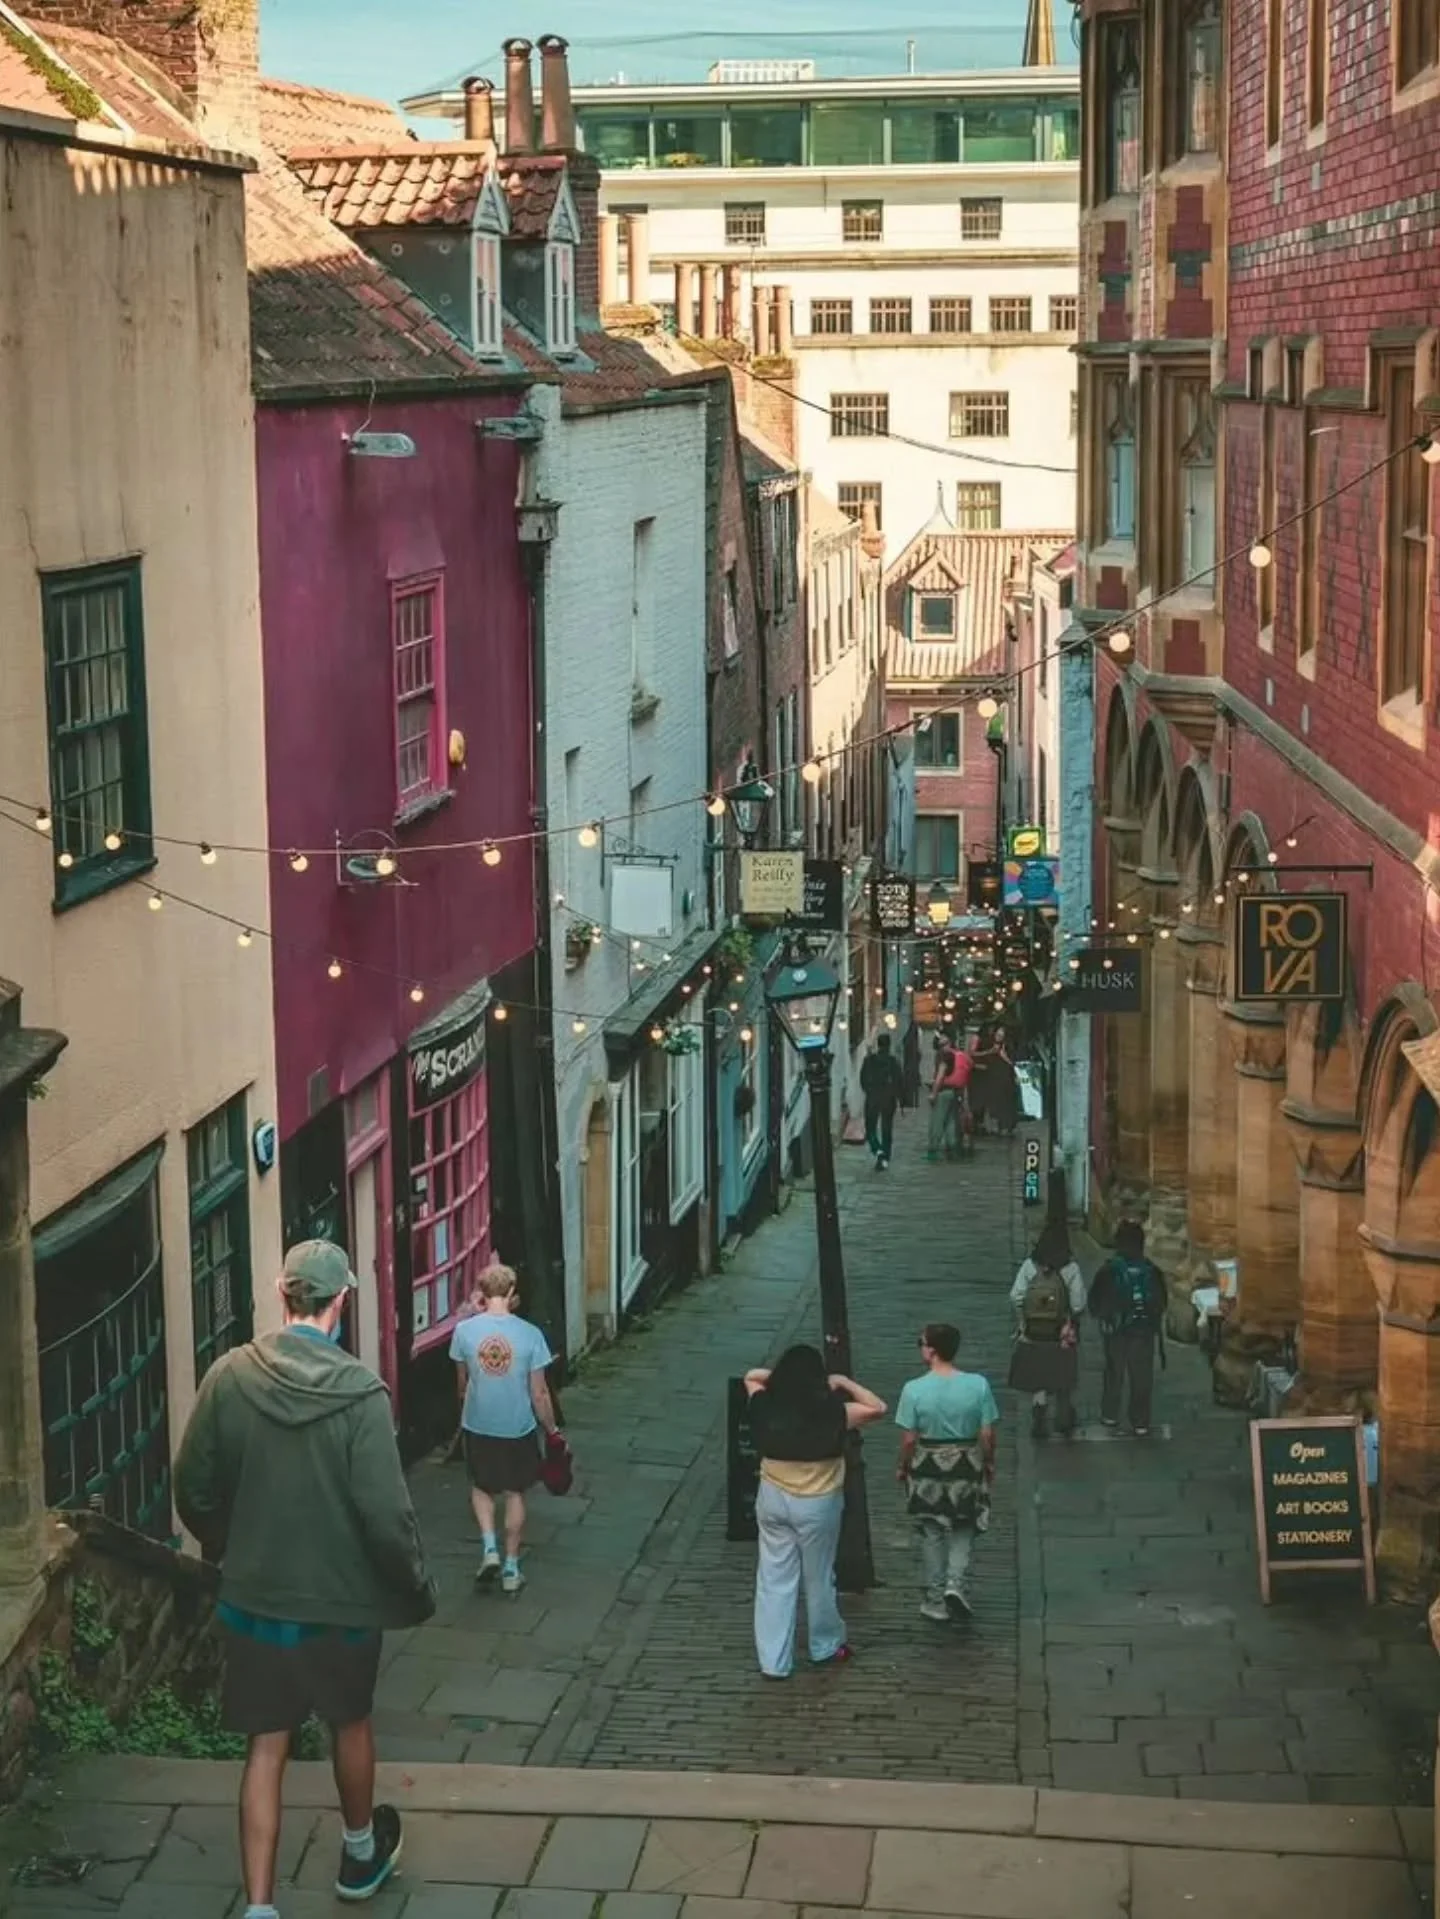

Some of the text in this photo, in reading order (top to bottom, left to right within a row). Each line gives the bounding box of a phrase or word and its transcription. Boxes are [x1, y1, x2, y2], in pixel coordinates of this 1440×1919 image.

[751, 855, 794, 867] Karen
[751, 869, 796, 886] Reilly
[1082, 972, 1135, 989] HUSK
[1289, 1441, 1326, 1464] Open
[1273, 1471, 1349, 1486] MAGAZINES
[1276, 1500, 1349, 1515] ART BOOKS
[1277, 1530, 1353, 1545] STATIONERY
